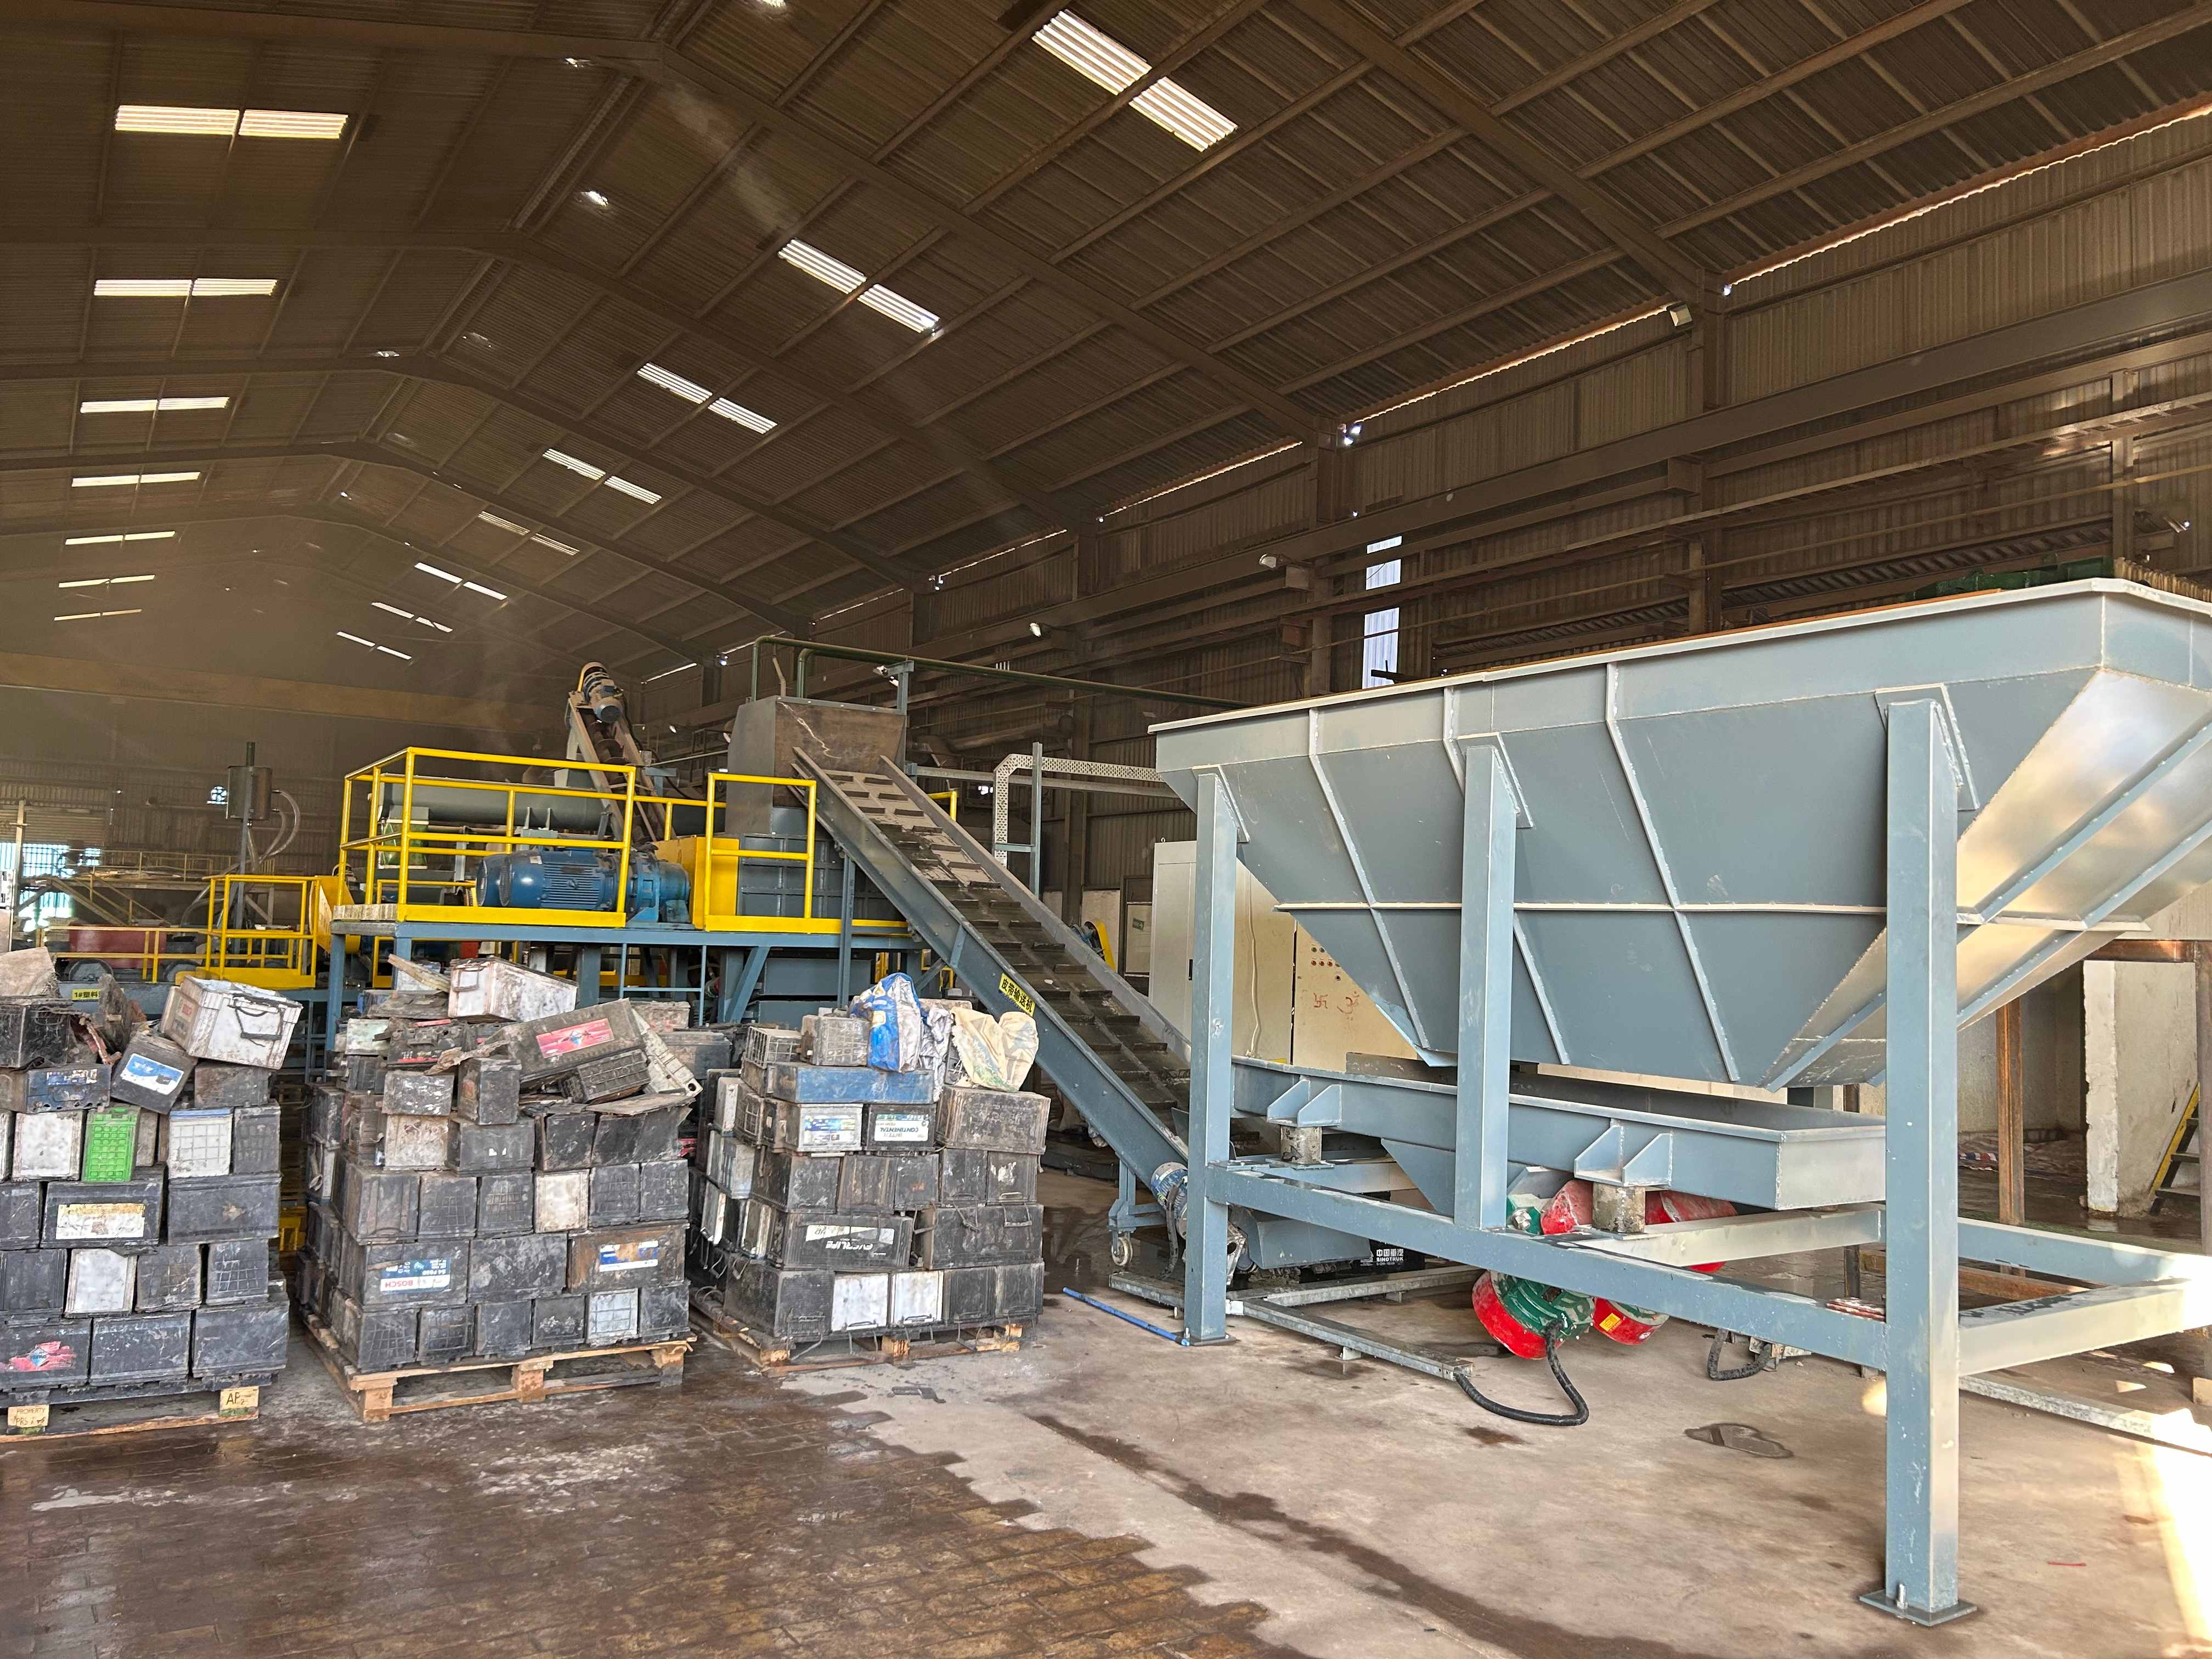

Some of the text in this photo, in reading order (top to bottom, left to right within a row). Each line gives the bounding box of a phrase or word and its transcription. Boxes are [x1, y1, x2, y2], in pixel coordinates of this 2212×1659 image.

[1002, 979, 1032, 1013] 皮带输送机
